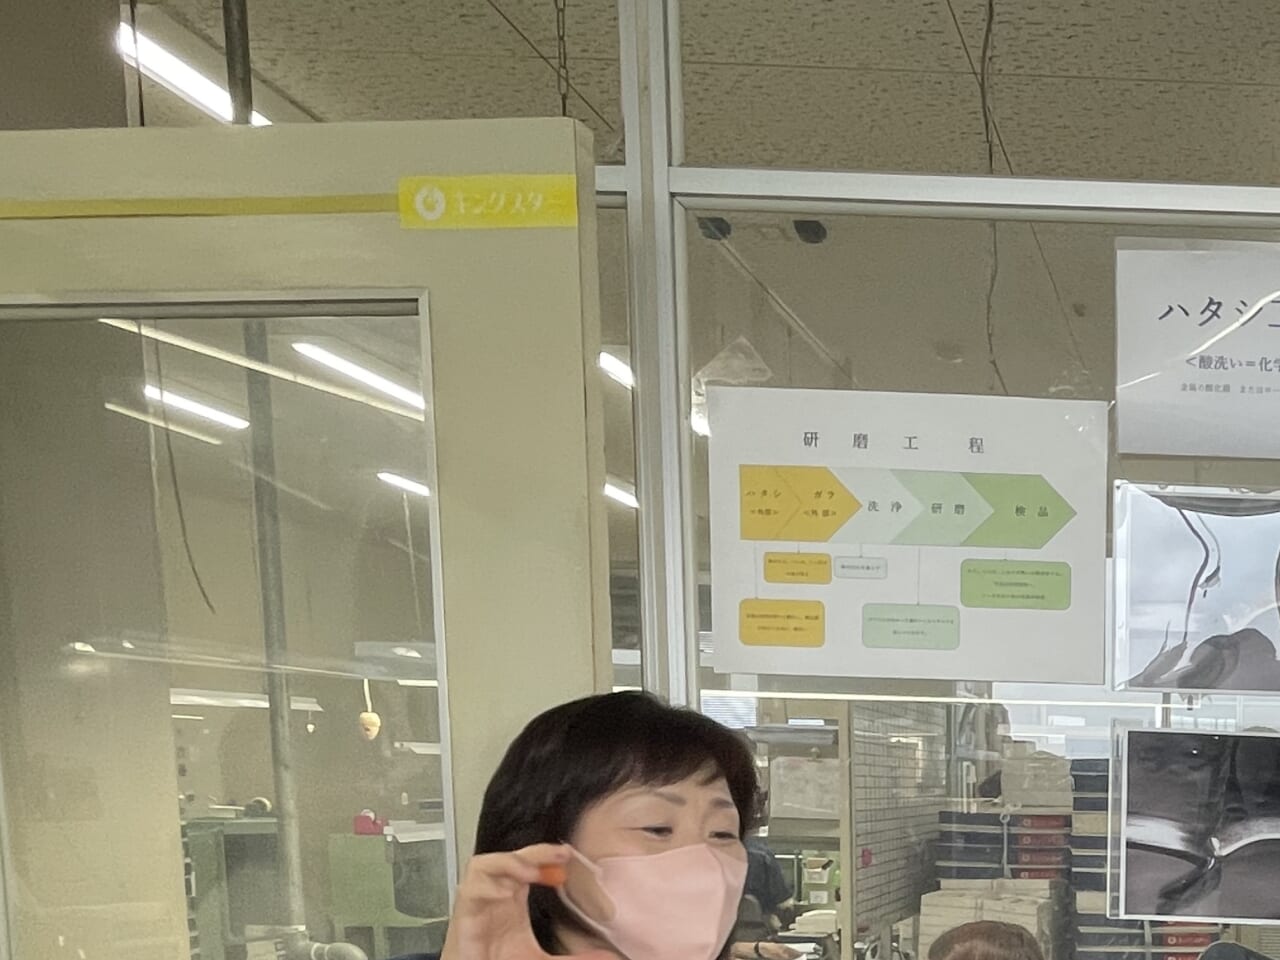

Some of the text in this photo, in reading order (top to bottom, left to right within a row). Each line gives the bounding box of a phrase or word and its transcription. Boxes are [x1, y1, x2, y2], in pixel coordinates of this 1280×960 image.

[803, 431, 985, 454] 研磨工程
[867, 501, 902, 513] 洗浄
[931, 502, 965, 515] 研磨
